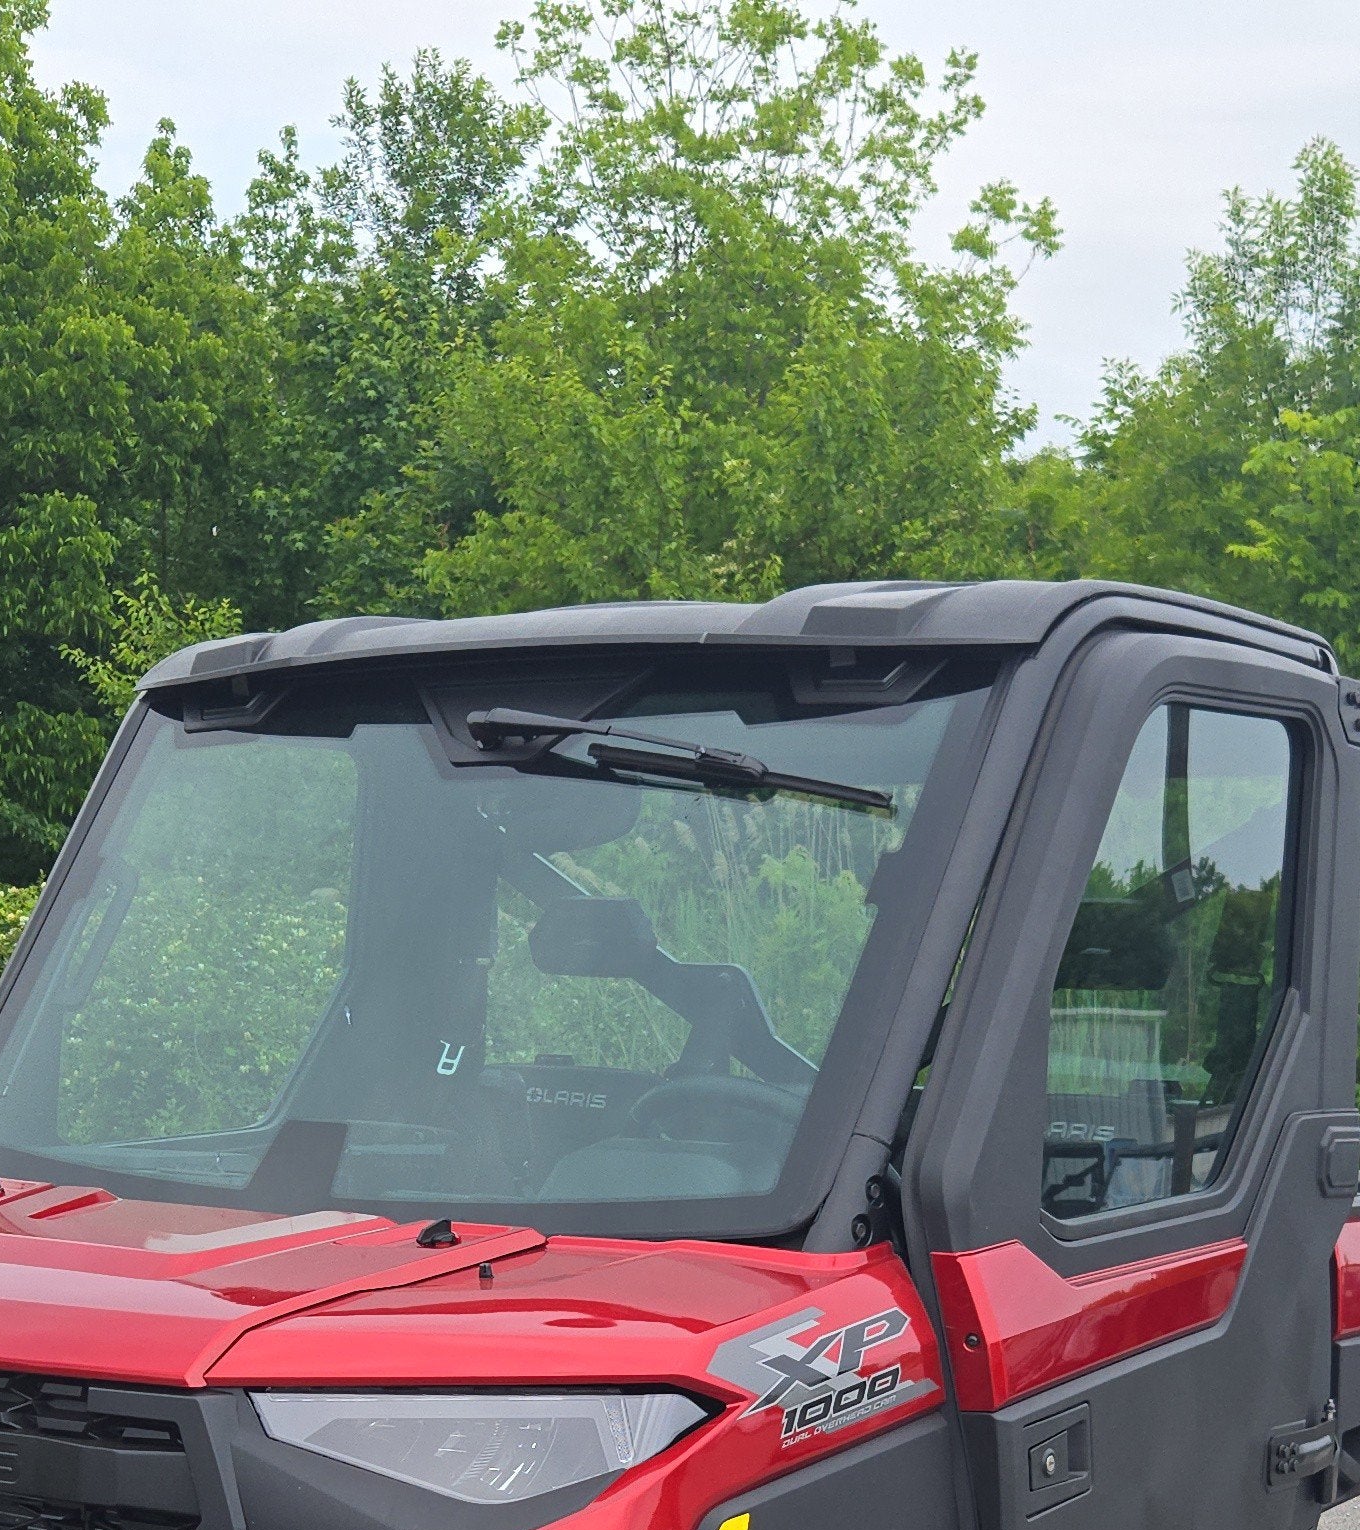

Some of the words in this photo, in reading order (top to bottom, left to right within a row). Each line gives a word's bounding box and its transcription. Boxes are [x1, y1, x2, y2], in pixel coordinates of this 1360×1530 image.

[526, 1087, 607, 1109] OLARIS
[737, 1308, 911, 1419] XP
[780, 1364, 902, 1440] 1000
[781, 1430, 812, 1449] DUAL
[813, 1405, 872, 1436] OVERHEAD
[872, 1394, 897, 1411] CAM
